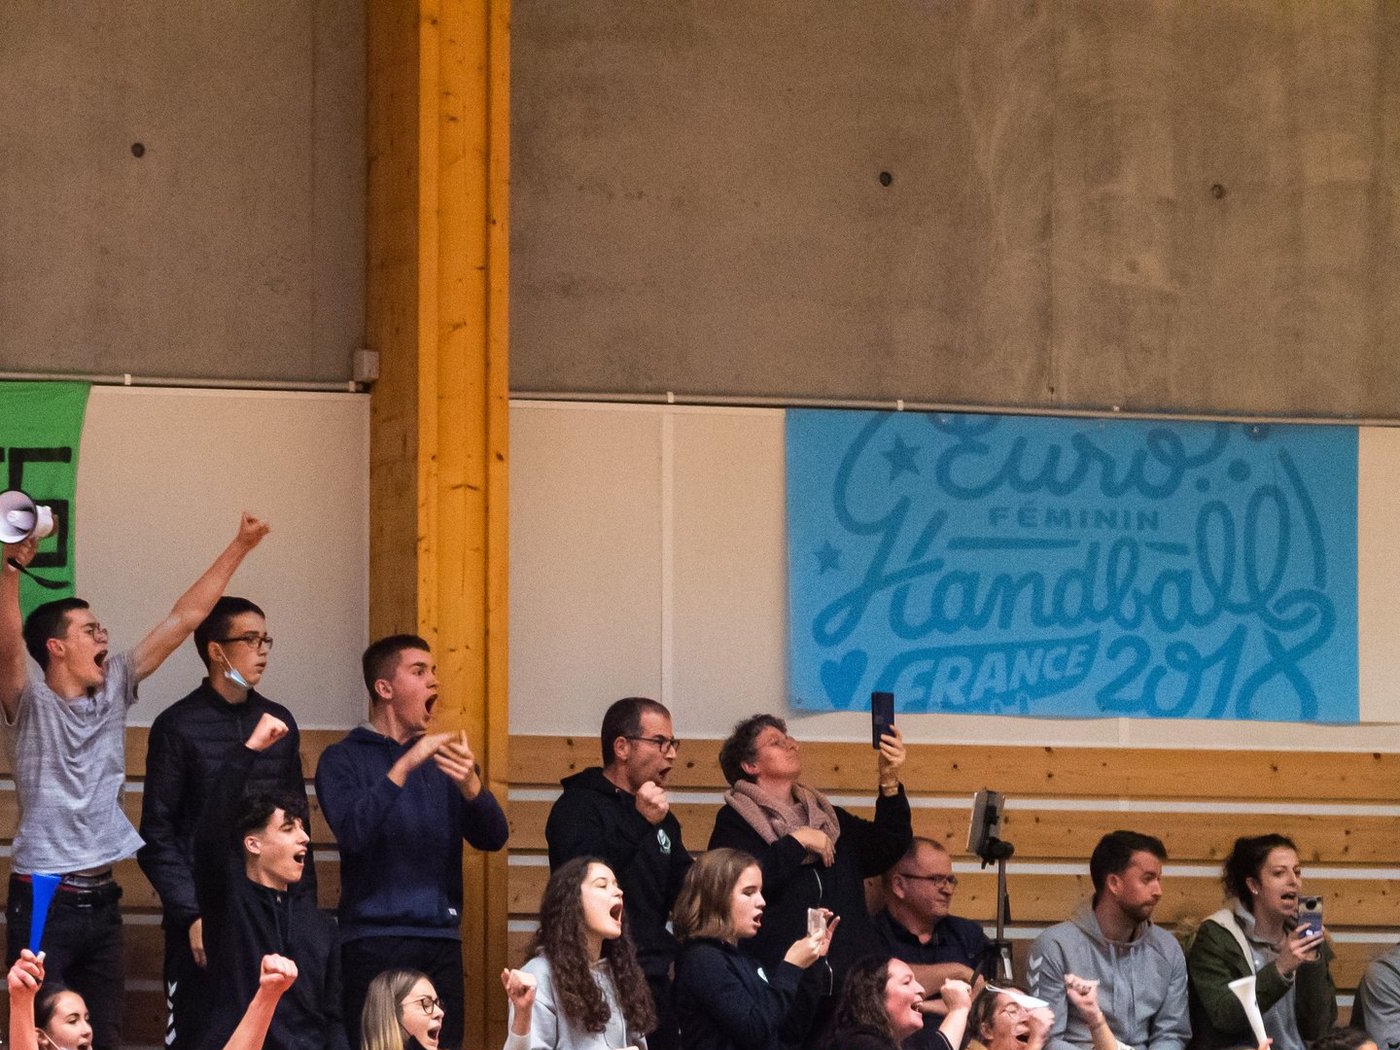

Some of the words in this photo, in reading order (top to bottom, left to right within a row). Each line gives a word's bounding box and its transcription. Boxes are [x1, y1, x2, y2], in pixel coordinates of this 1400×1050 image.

[929, 413, 1204, 500] Euro
[812, 450, 1300, 647] Handball
[987, 498, 1159, 532] FÉMININ
[892, 644, 1090, 713] FRANCE
[1094, 600, 1332, 720] 2018
